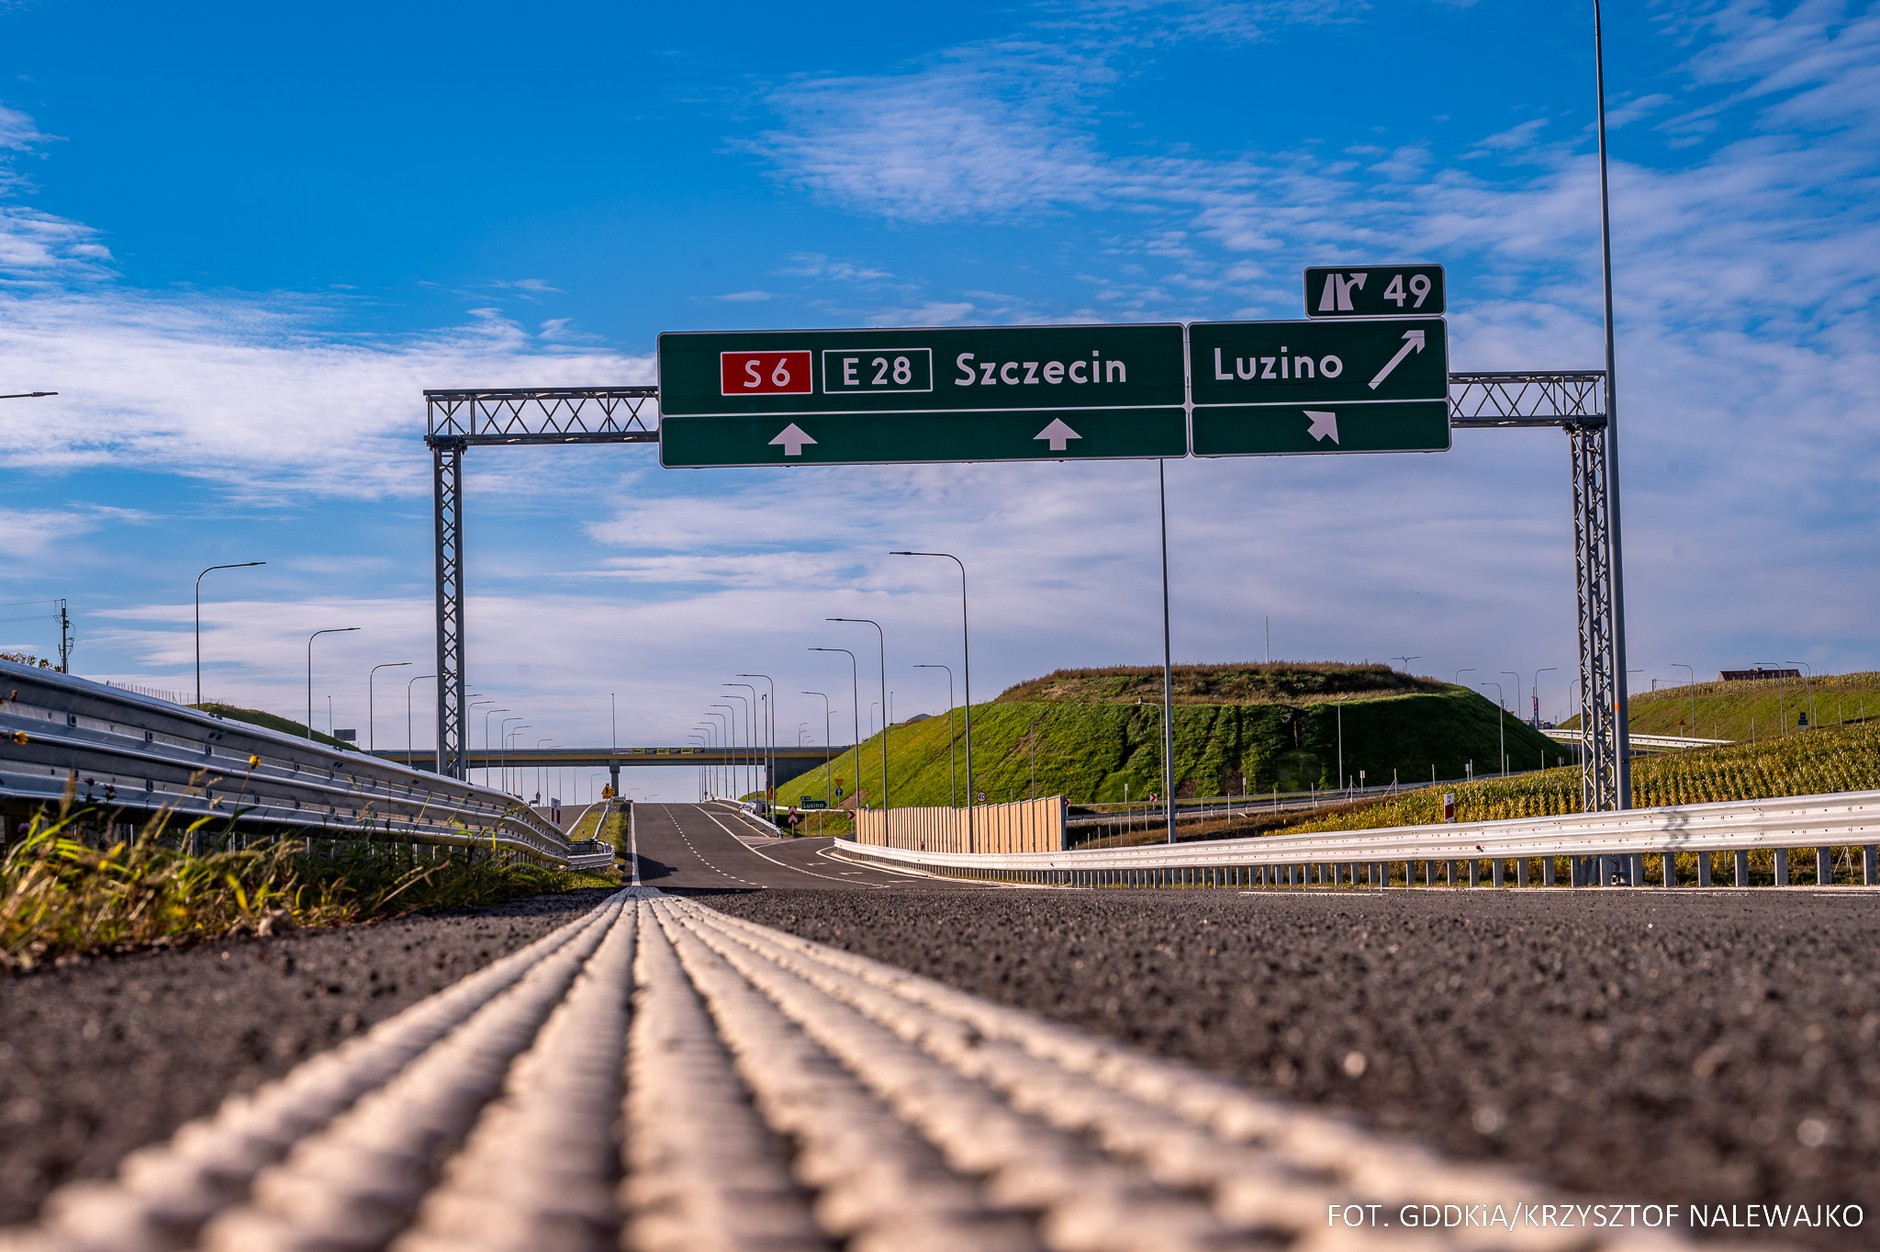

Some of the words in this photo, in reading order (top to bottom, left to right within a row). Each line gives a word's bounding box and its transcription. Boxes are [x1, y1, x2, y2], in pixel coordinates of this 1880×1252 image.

[1383, 274, 1431, 308] 49
[954, 350, 1128, 387] Szczecin
[1214, 346, 1343, 381] Luzino
